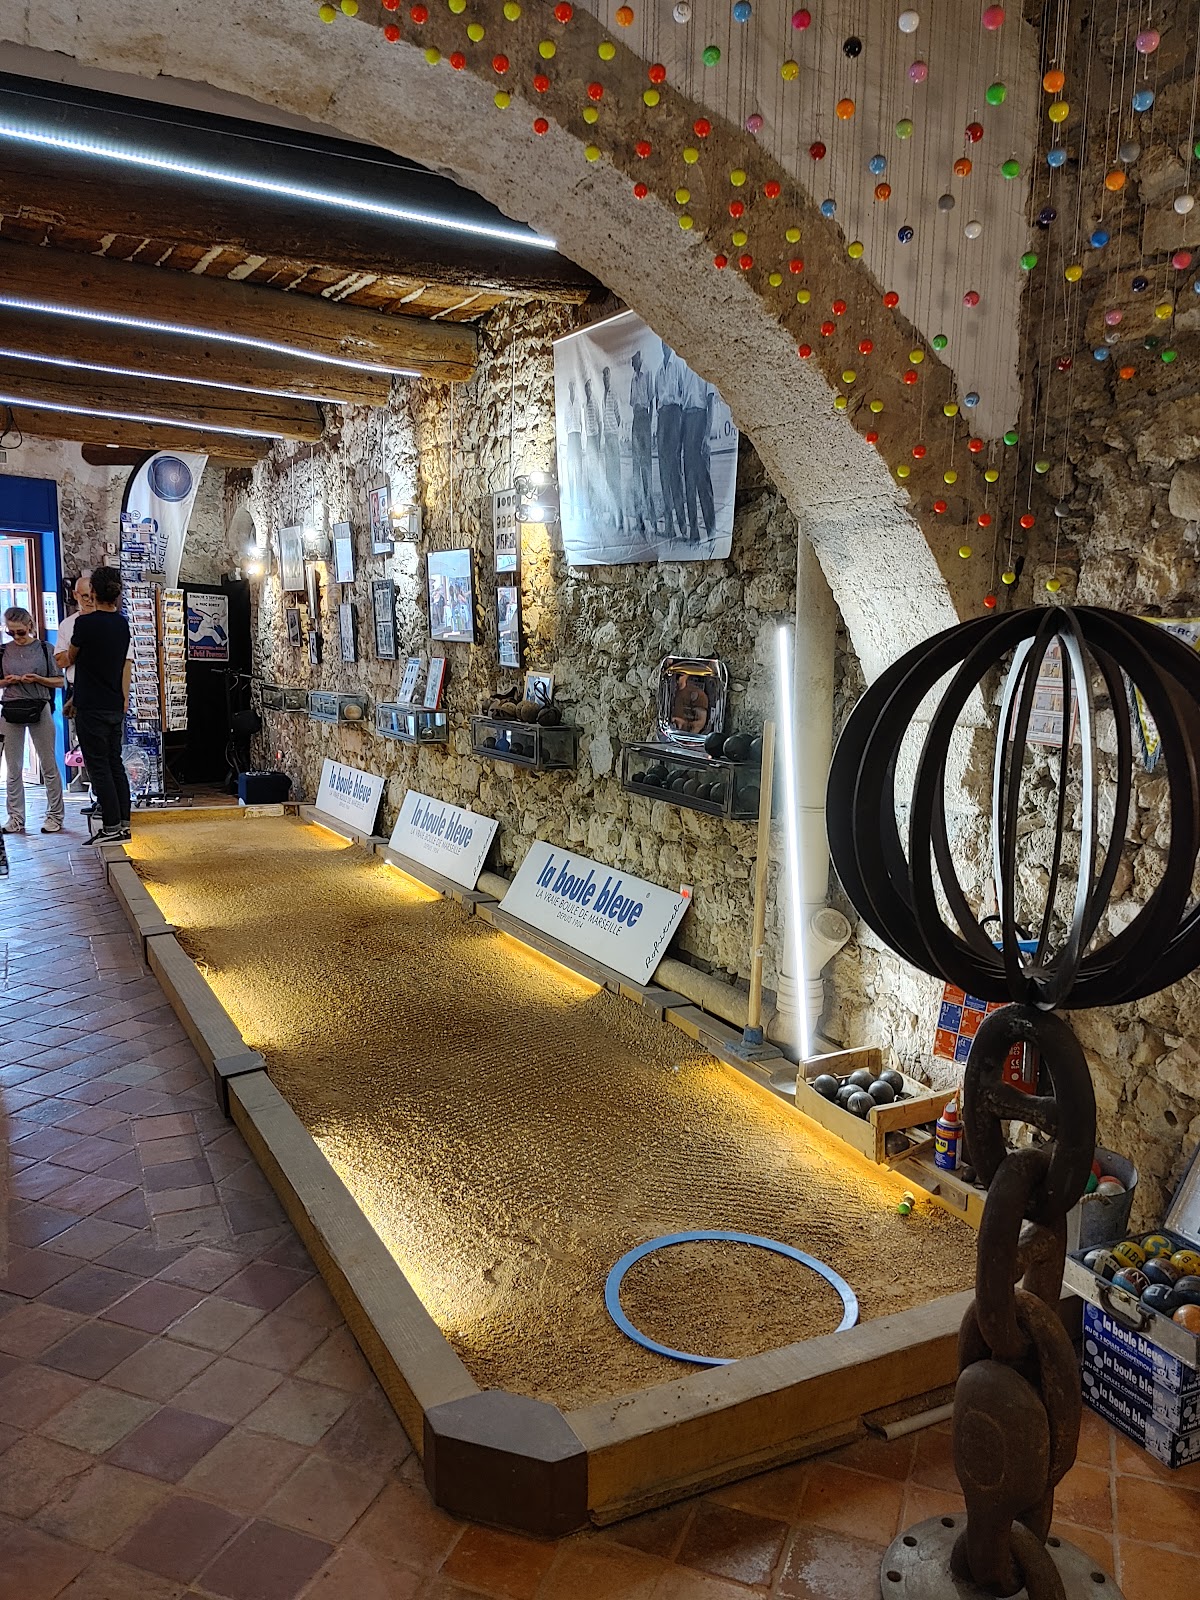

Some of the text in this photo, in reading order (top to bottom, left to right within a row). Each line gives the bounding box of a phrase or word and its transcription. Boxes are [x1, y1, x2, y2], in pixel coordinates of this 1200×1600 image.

[329, 766, 372, 803] la boule bleue
[411, 799, 422, 826] la
[420, 802, 446, 837] boule
[444, 812, 473, 848] bleue
[536, 854, 643, 927] la boule bleue
[536, 889, 622, 936] LA VRAIE BOULE DE MARSEILLE
[556, 912, 572, 925] DEPUIS
[1103, 1315, 1111, 1332] la
[1112, 1321, 1136, 1348] boule
[1138, 1338, 1163, 1364] bleue
[1103, 1337, 1119, 1351] BOULES
[1103, 1372, 1120, 1387] BOULES
[1104, 1351, 1112, 1368] la
[1114, 1358, 1137, 1383] boule
[1139, 1375, 1163, 1401] bleue
[1100, 1383, 1107, 1399] la
[1109, 1390, 1131, 1416] boule
[1132, 1408, 1155, 1435] bleue
